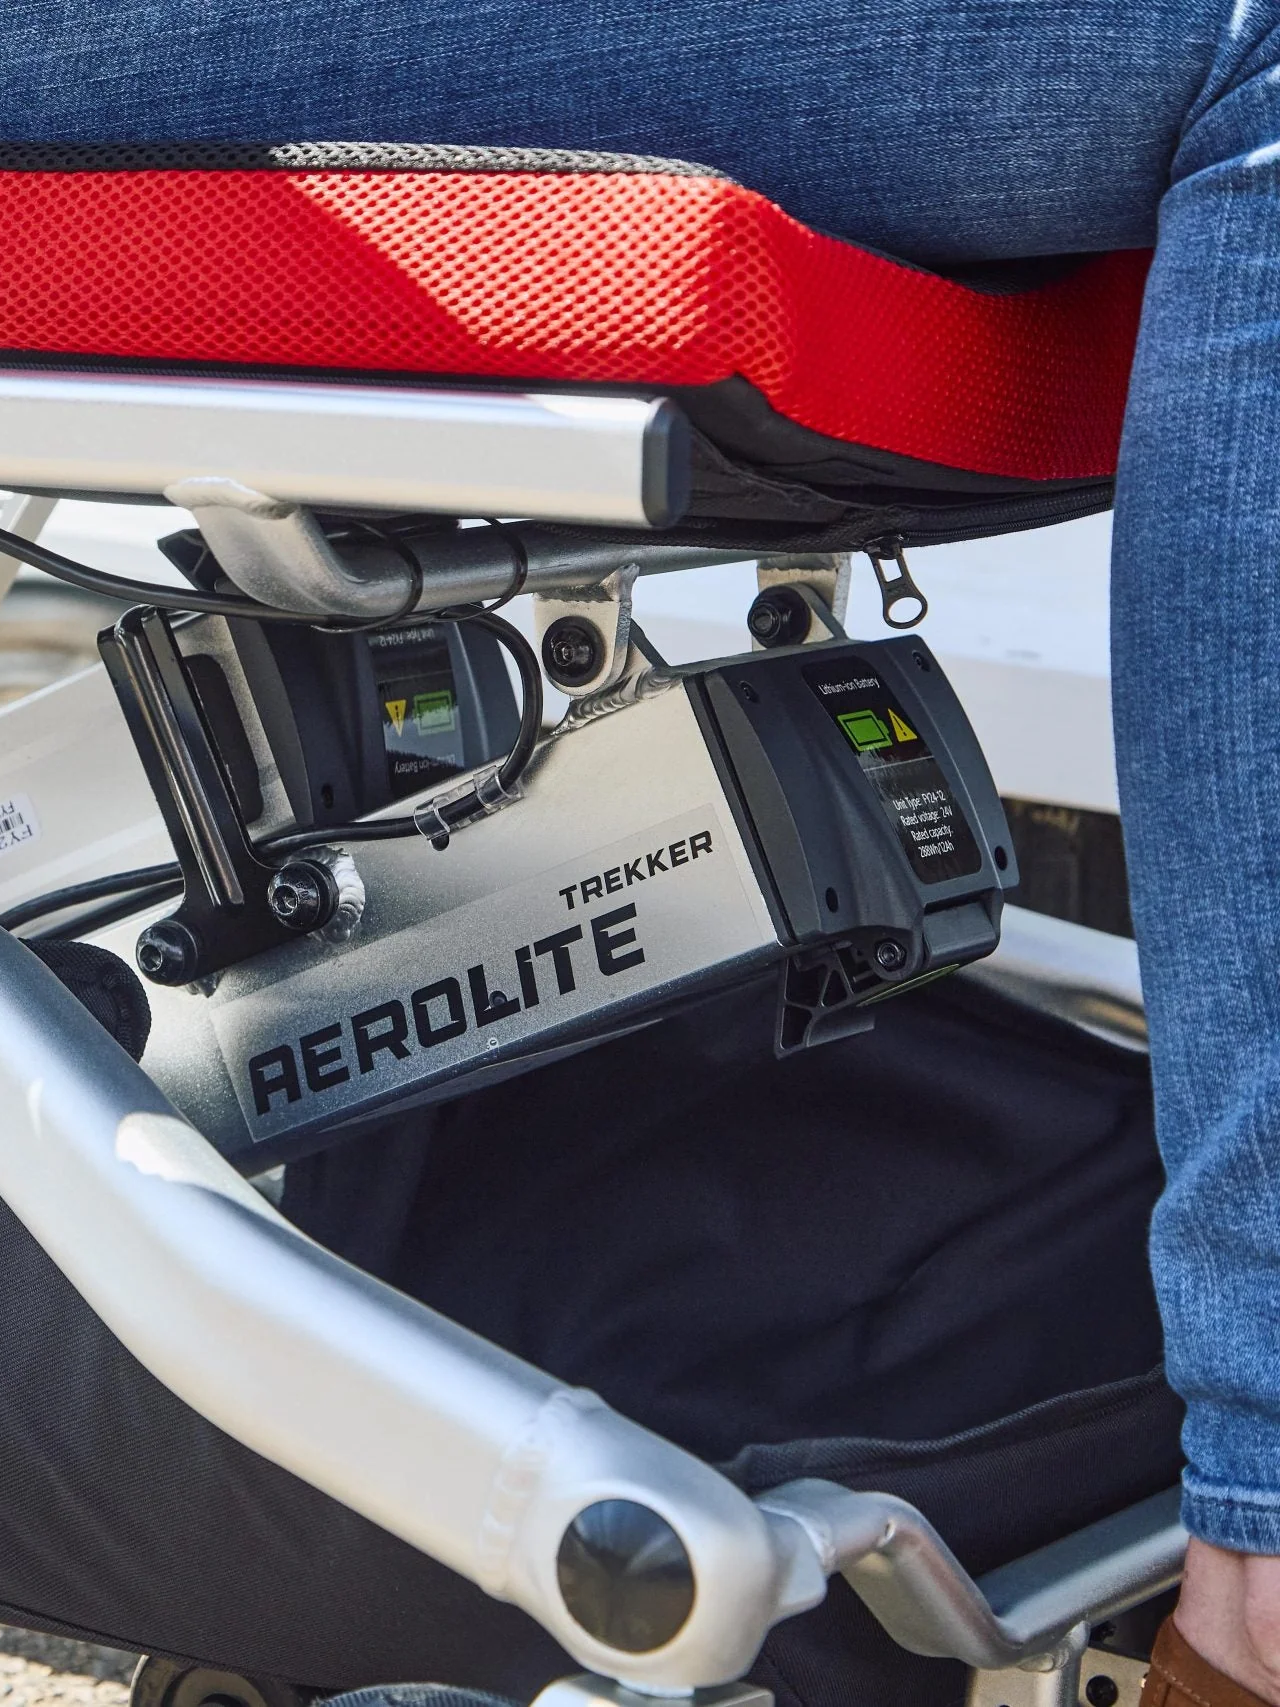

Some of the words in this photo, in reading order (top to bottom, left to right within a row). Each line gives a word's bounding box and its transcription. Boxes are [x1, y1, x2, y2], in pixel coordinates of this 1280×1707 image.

[853, 677, 880, 689] Battery
[893, 799, 908, 811] Unit
[922, 790, 946, 804] FY24-12
[900, 813, 919, 827] Rated
[940, 805, 953, 818] 24V
[911, 828, 930, 842] Rated
[559, 830, 714, 910] TREKKER
[248, 902, 646, 1116] AEROLITE
